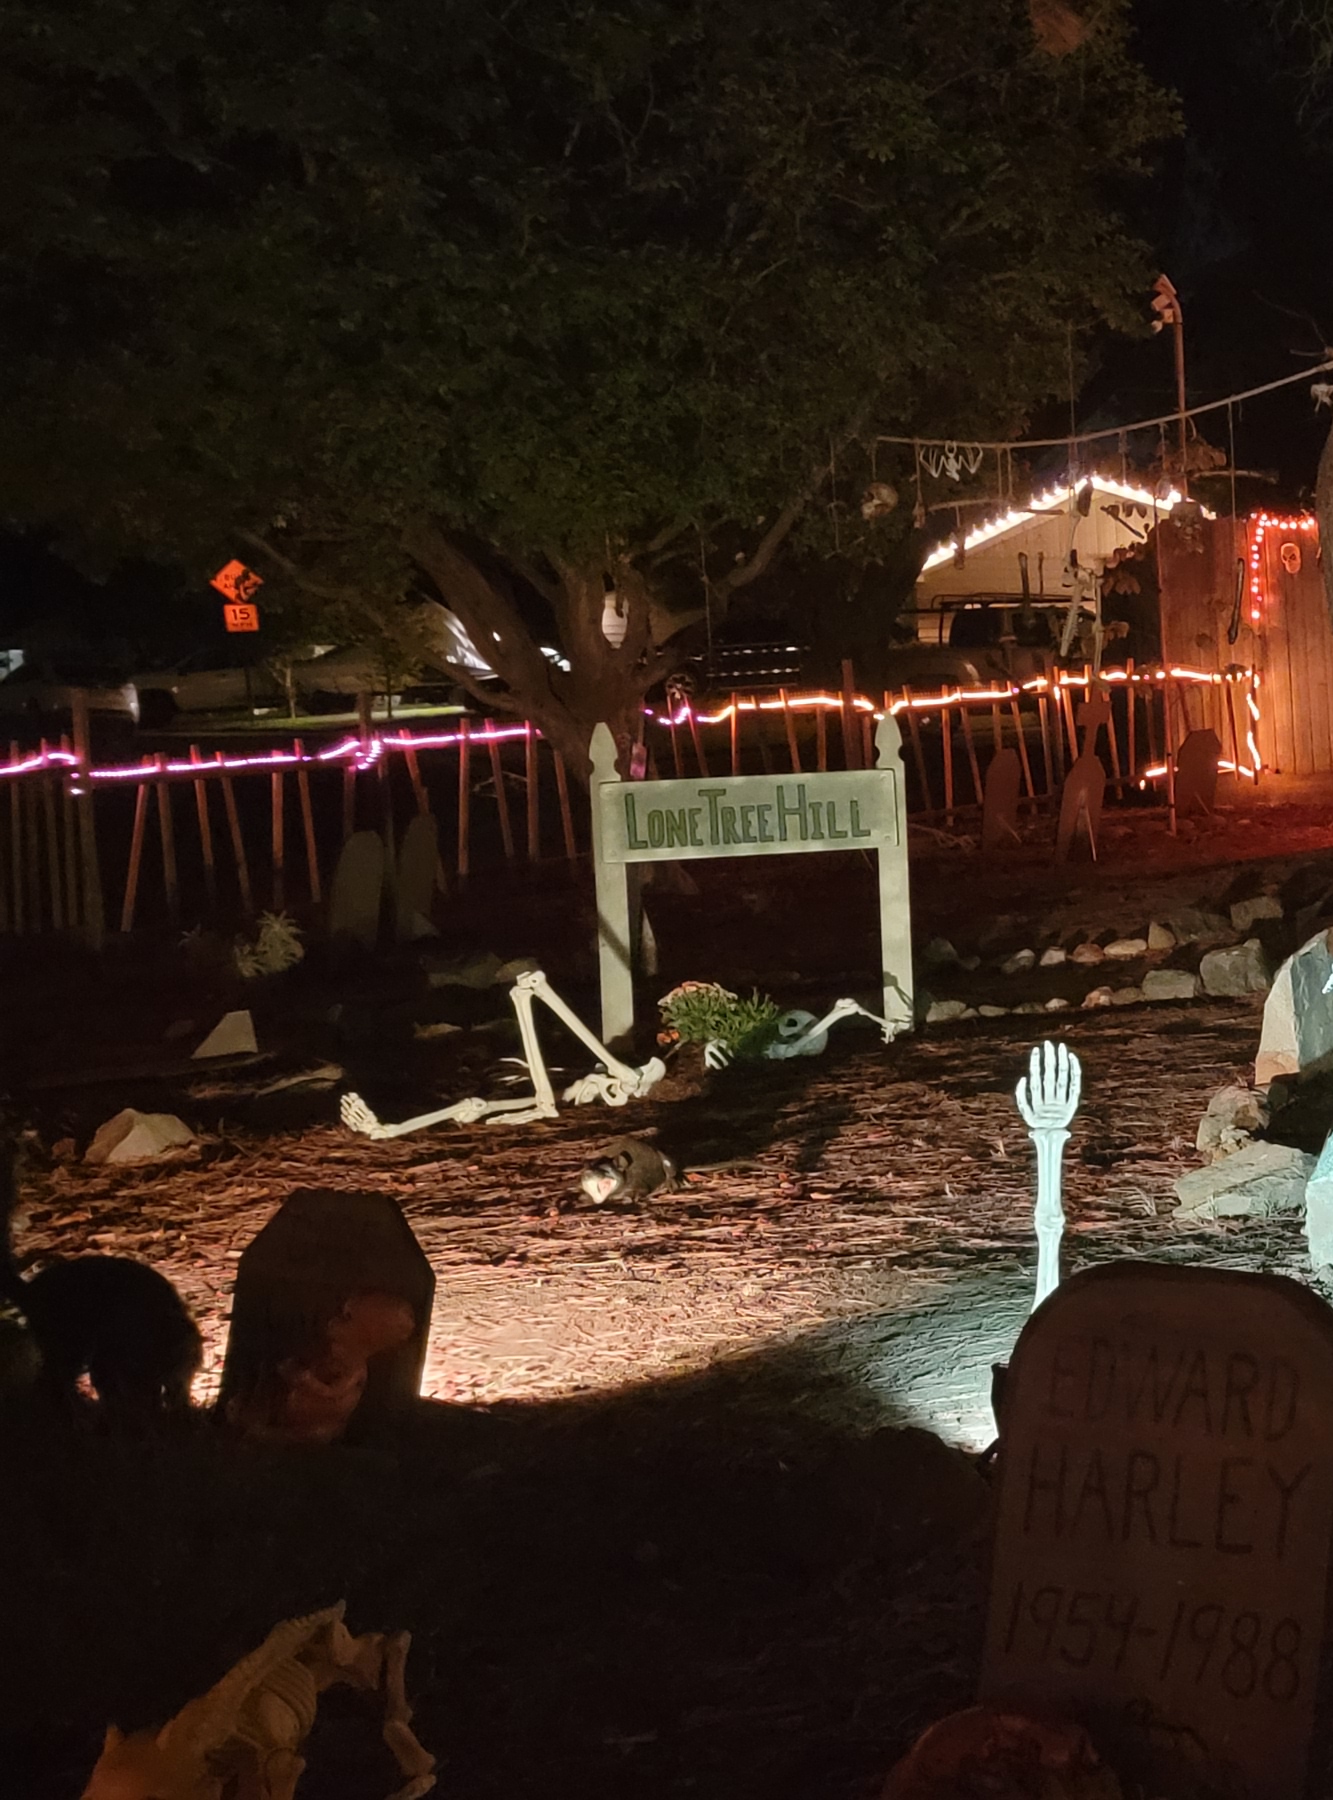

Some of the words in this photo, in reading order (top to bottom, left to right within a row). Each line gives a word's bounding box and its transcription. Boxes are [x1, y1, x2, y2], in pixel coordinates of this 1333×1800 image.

[232, 608, 250, 621] 15
[1046, 1338, 1301, 1443] EDWARD
[1023, 1443, 1313, 1560] HARLEY
[1004, 1580, 1303, 1704] 1954-1988
